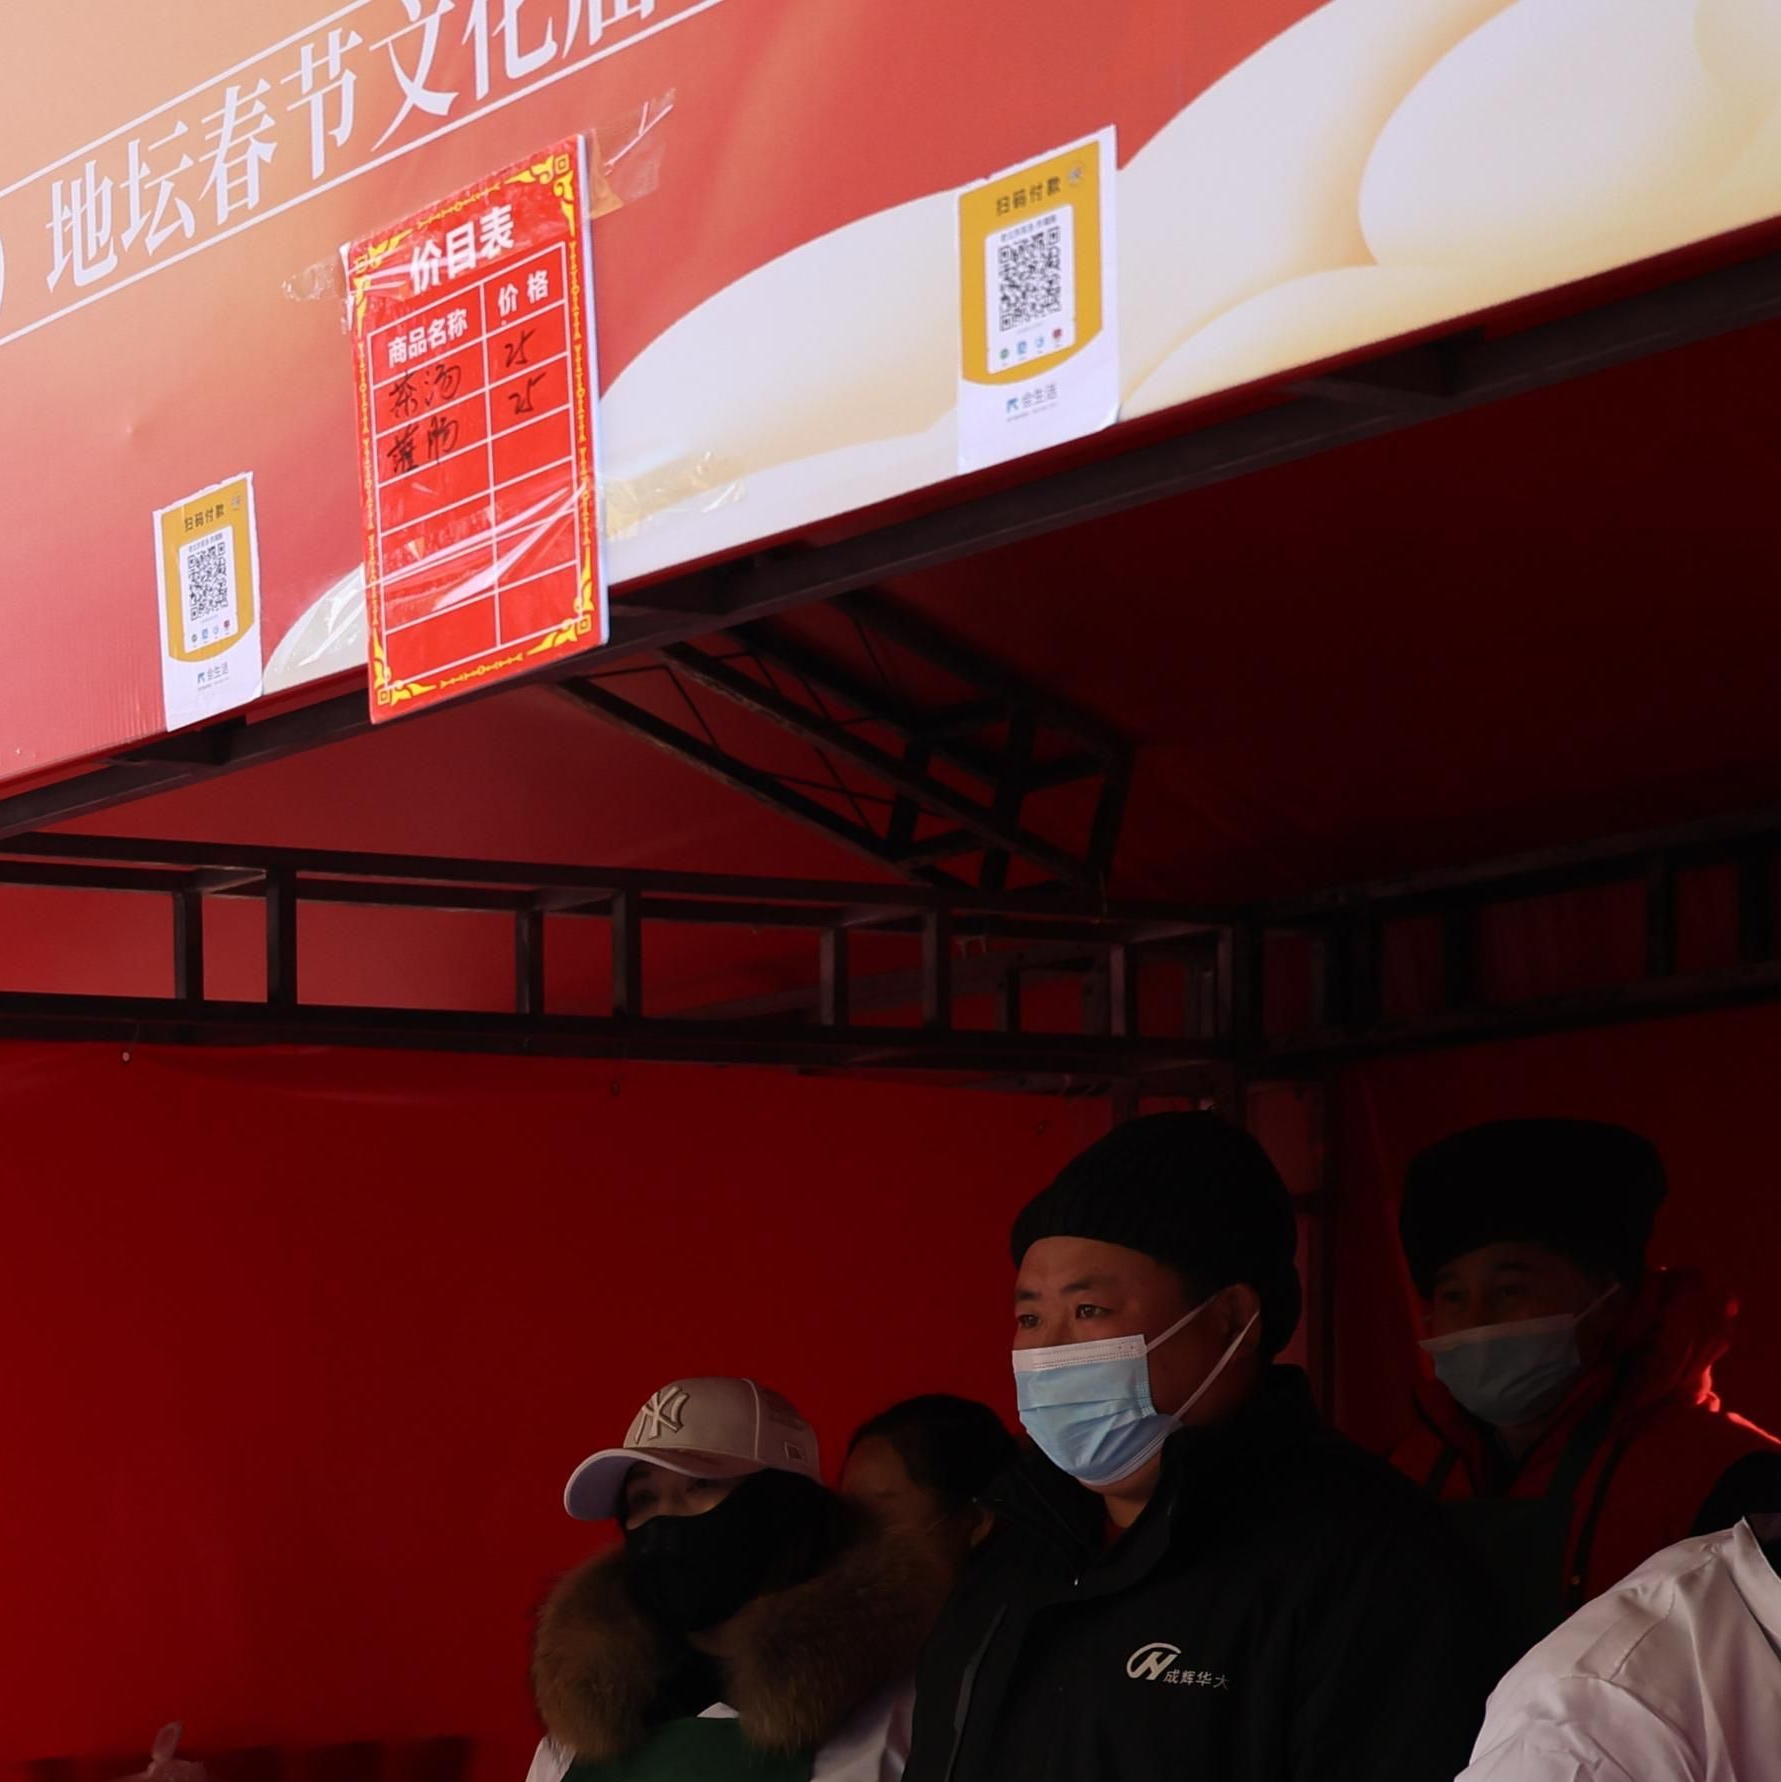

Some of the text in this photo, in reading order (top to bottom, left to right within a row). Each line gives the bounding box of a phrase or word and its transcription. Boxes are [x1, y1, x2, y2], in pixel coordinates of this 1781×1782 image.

[409, 204, 515, 294] 价目表
[388, 308, 469, 368] 商品名称
[504, 329, 535, 367] 25
[508, 372, 547, 415] 25
